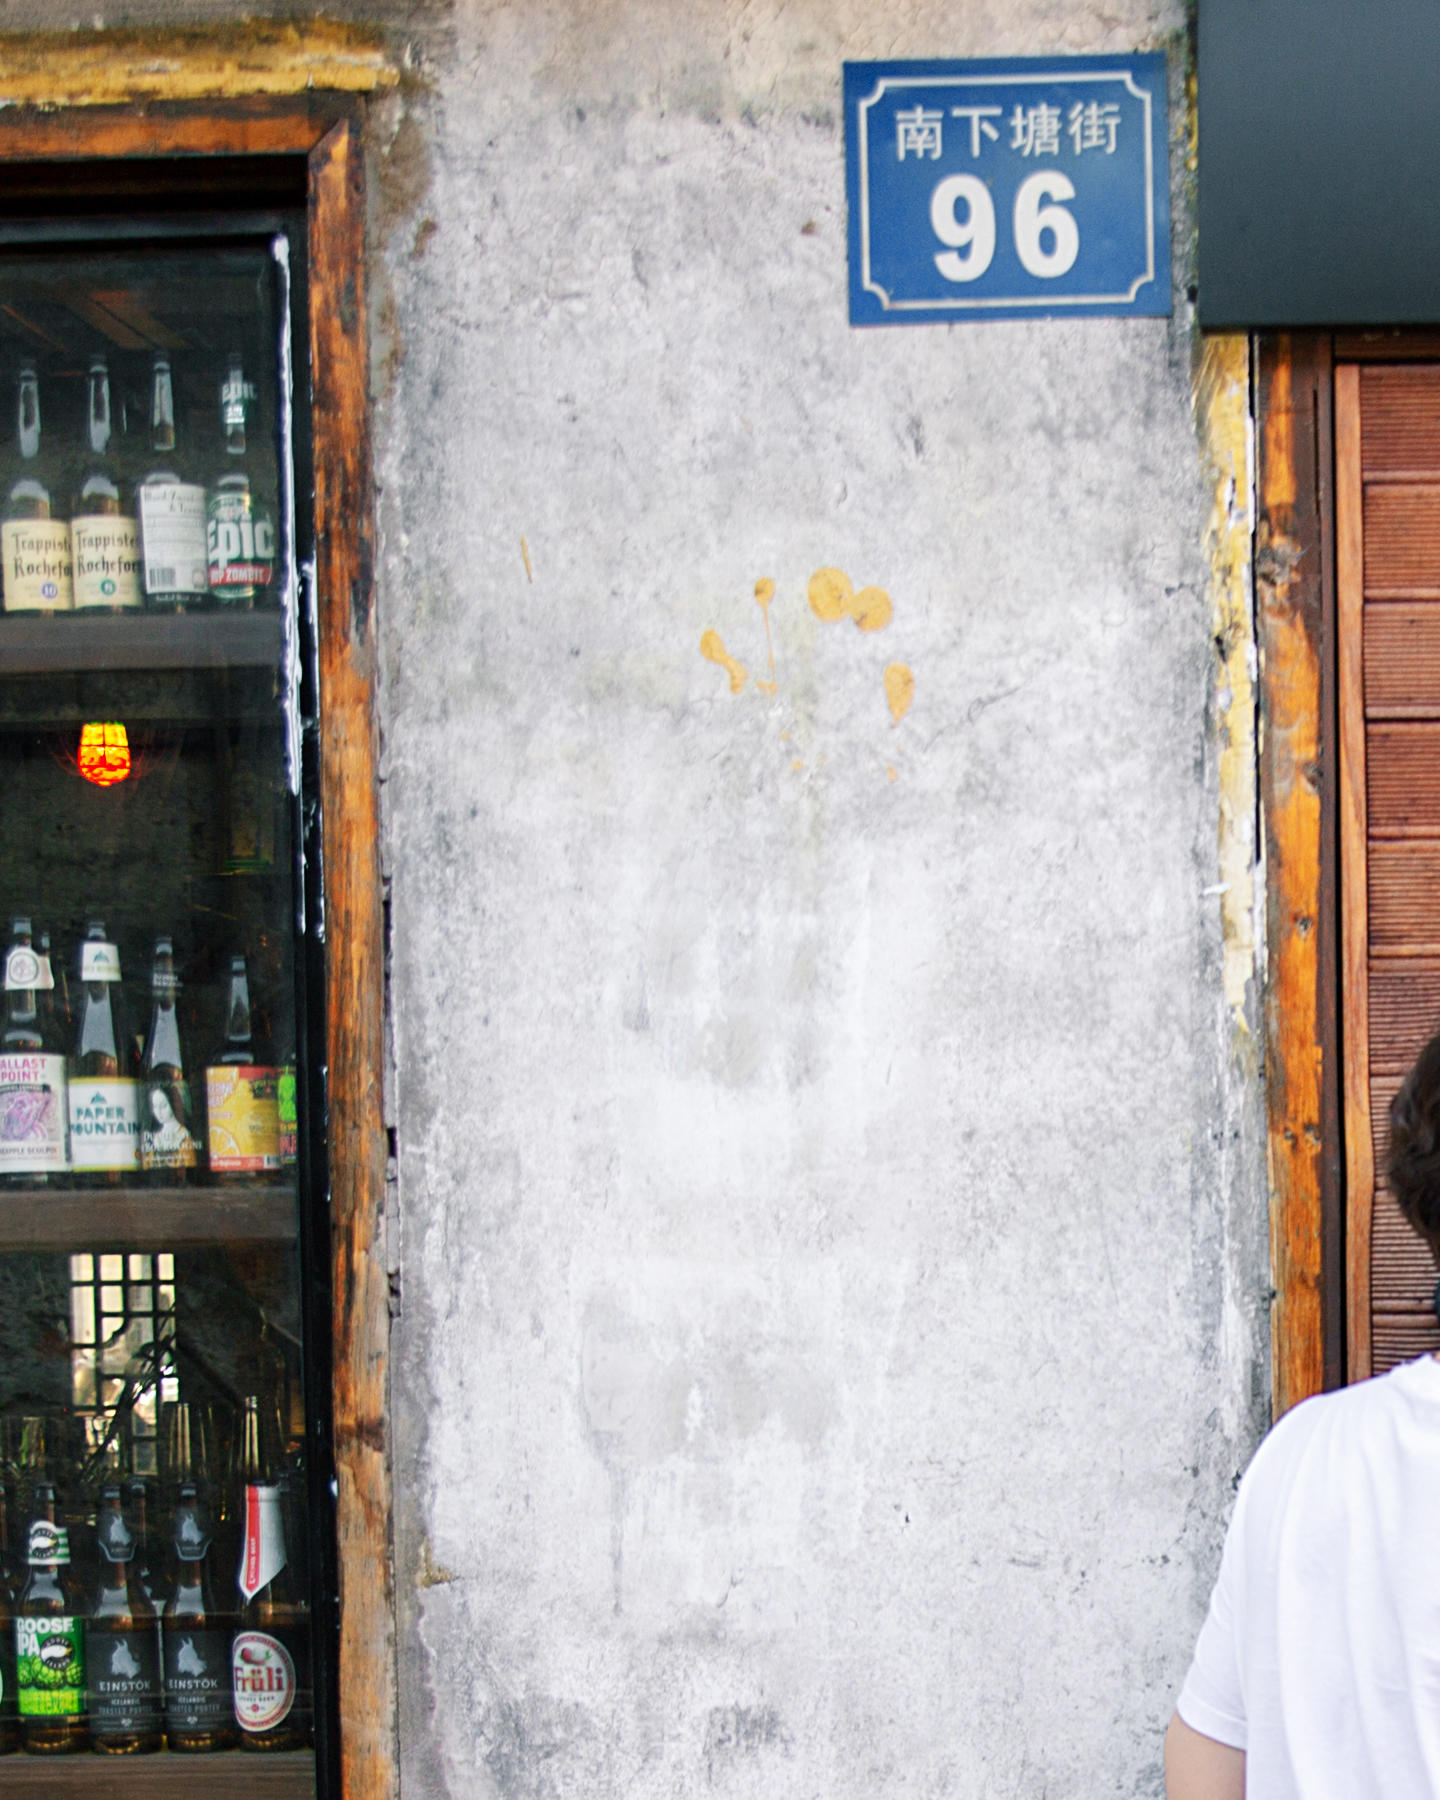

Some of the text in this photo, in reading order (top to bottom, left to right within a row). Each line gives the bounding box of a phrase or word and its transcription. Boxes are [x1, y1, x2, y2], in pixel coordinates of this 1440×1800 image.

[895, 102, 1121, 161] 南下塘街
[930, 170, 1079, 282] 96
[11, 533, 72, 554] Trappist
[76, 530, 137, 551] Trappiste
[14, 556, 72, 580] Rochefo
[77, 554, 138, 577] Rochefor
[1, 1071, 39, 1082] POINT
[76, 1107, 125, 1118] PAPER
[16, 1617, 74, 1633] GOOSE
[17, 1633, 40, 1657] IPA
[99, 1679, 151, 1692] EINSTÖK
[168, 1677, 218, 1690] EINSTÖK
